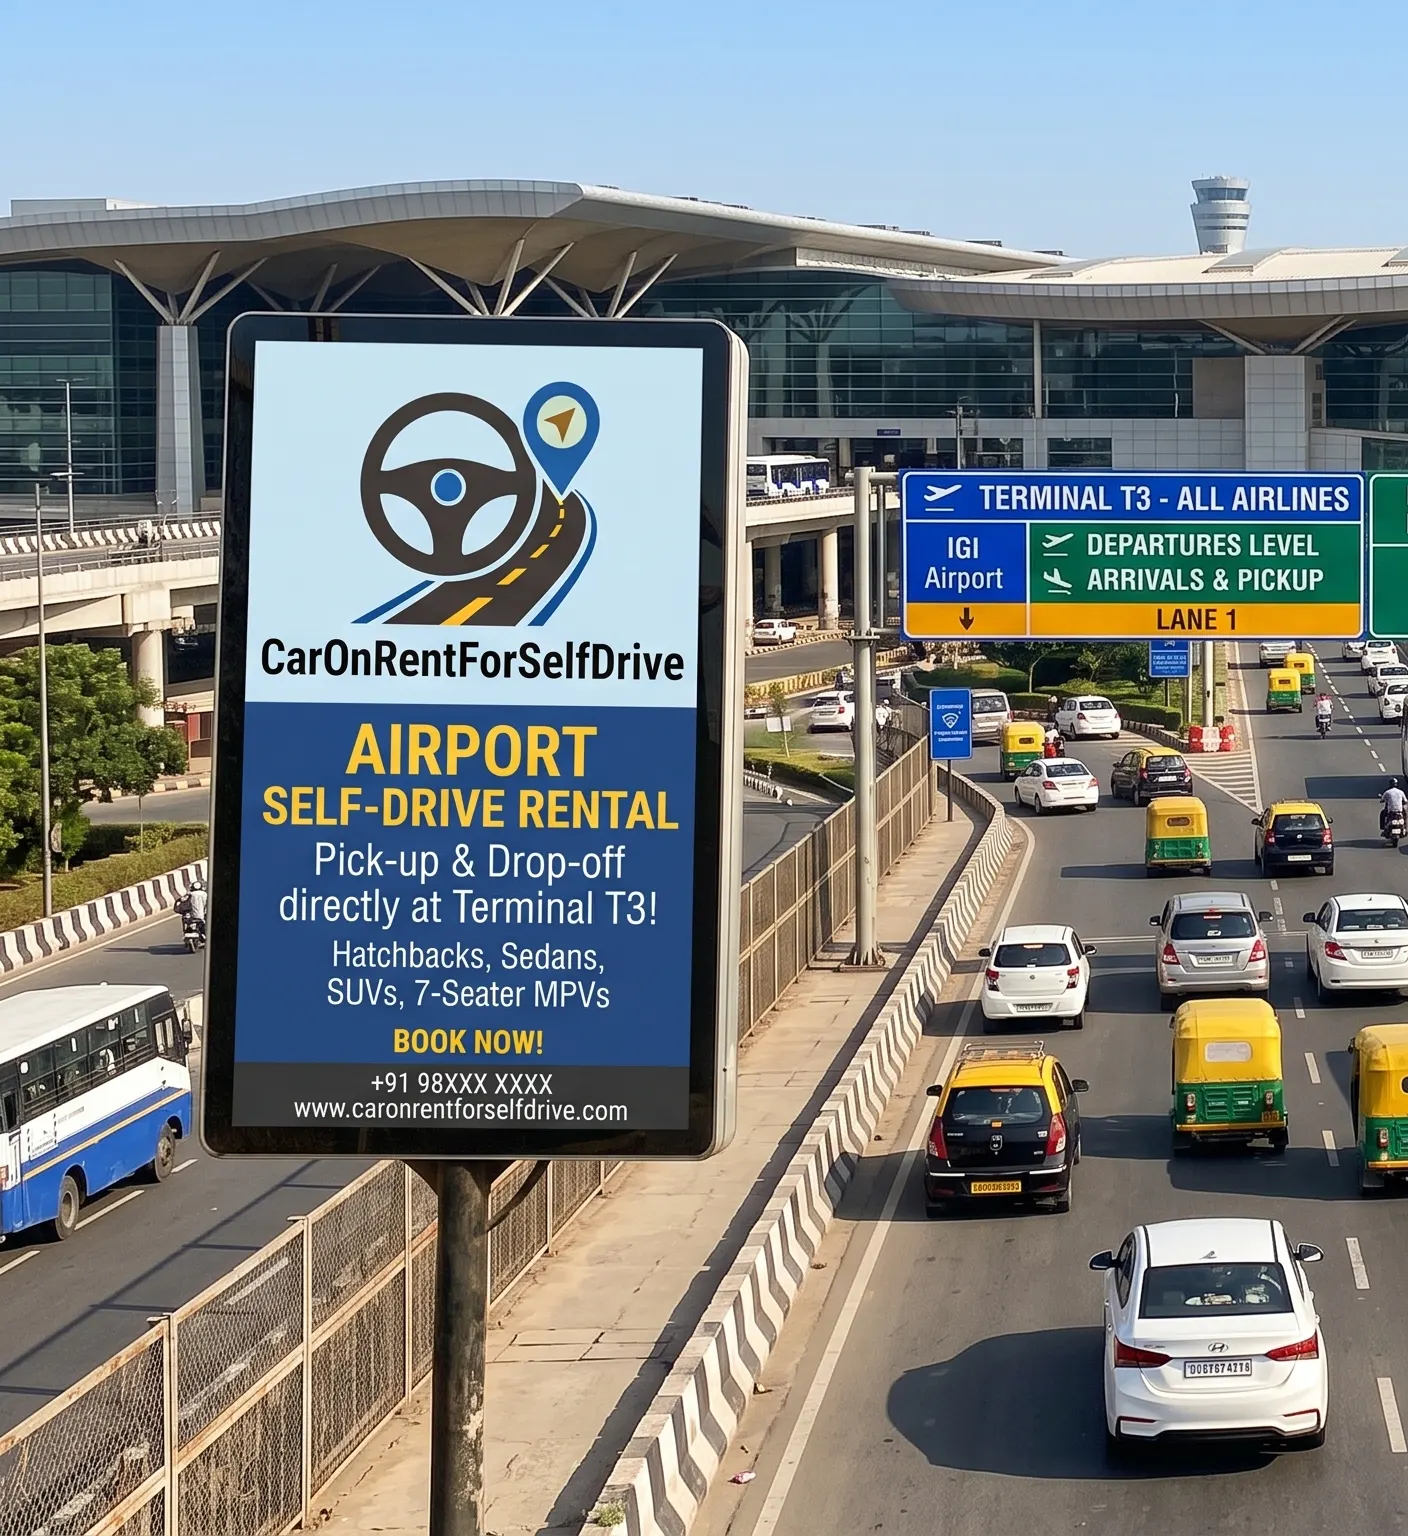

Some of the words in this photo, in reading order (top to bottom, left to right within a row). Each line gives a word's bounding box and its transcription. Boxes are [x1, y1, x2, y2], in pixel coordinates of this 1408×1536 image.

[979, 486, 1112, 510] TERMINAL
[1120, 486, 1150, 510] T3
[1177, 487, 1224, 510] ALL
[1232, 487, 1349, 511] AIRLINES
[949, 537, 978, 559] IGI
[1088, 534, 1241, 556] DEPARTURES
[1250, 534, 1319, 555] LEVEL
[925, 567, 1003, 593] Airport
[1088, 569, 1204, 590] ARRIVALS
[1213, 569, 1228, 590] &
[1239, 569, 1323, 591] PICKUP
[1158, 609, 1217, 630] LANE
[1226, 609, 1235, 630] 1
[262, 638, 684, 680] CarOnRentForSelfDrive
[346, 724, 597, 776] AIRPORT
[263, 786, 504, 827] SELF-DRIVE
[520, 790, 678, 829] RENTAL
[316, 842, 438, 884] Pick-up
[453, 844, 475, 877] &
[490, 844, 625, 886] Drop-off
[280, 888, 400, 929] directly
[412, 892, 441, 922] at
[453, 890, 592, 924] Terminal
[605, 891, 655, 924] T3!
[334, 941, 490, 973] Hatchbacks,
[502, 942, 603, 974] Sedans,
[328, 978, 403, 1010] SUVs,
[415, 979, 525, 1007] 7-Seater
[535, 981, 609, 1008] MPVs
[394, 1029, 466, 1053] BOOK
[475, 1030, 542, 1054] NOW!
[372, 1072, 406, 1092] +91
[418, 1073, 487, 1093] 98XXX
[495, 1074, 552, 1094] XXXX
[295, 1098, 627, 1120] www.caronrentforselfdrive.com
